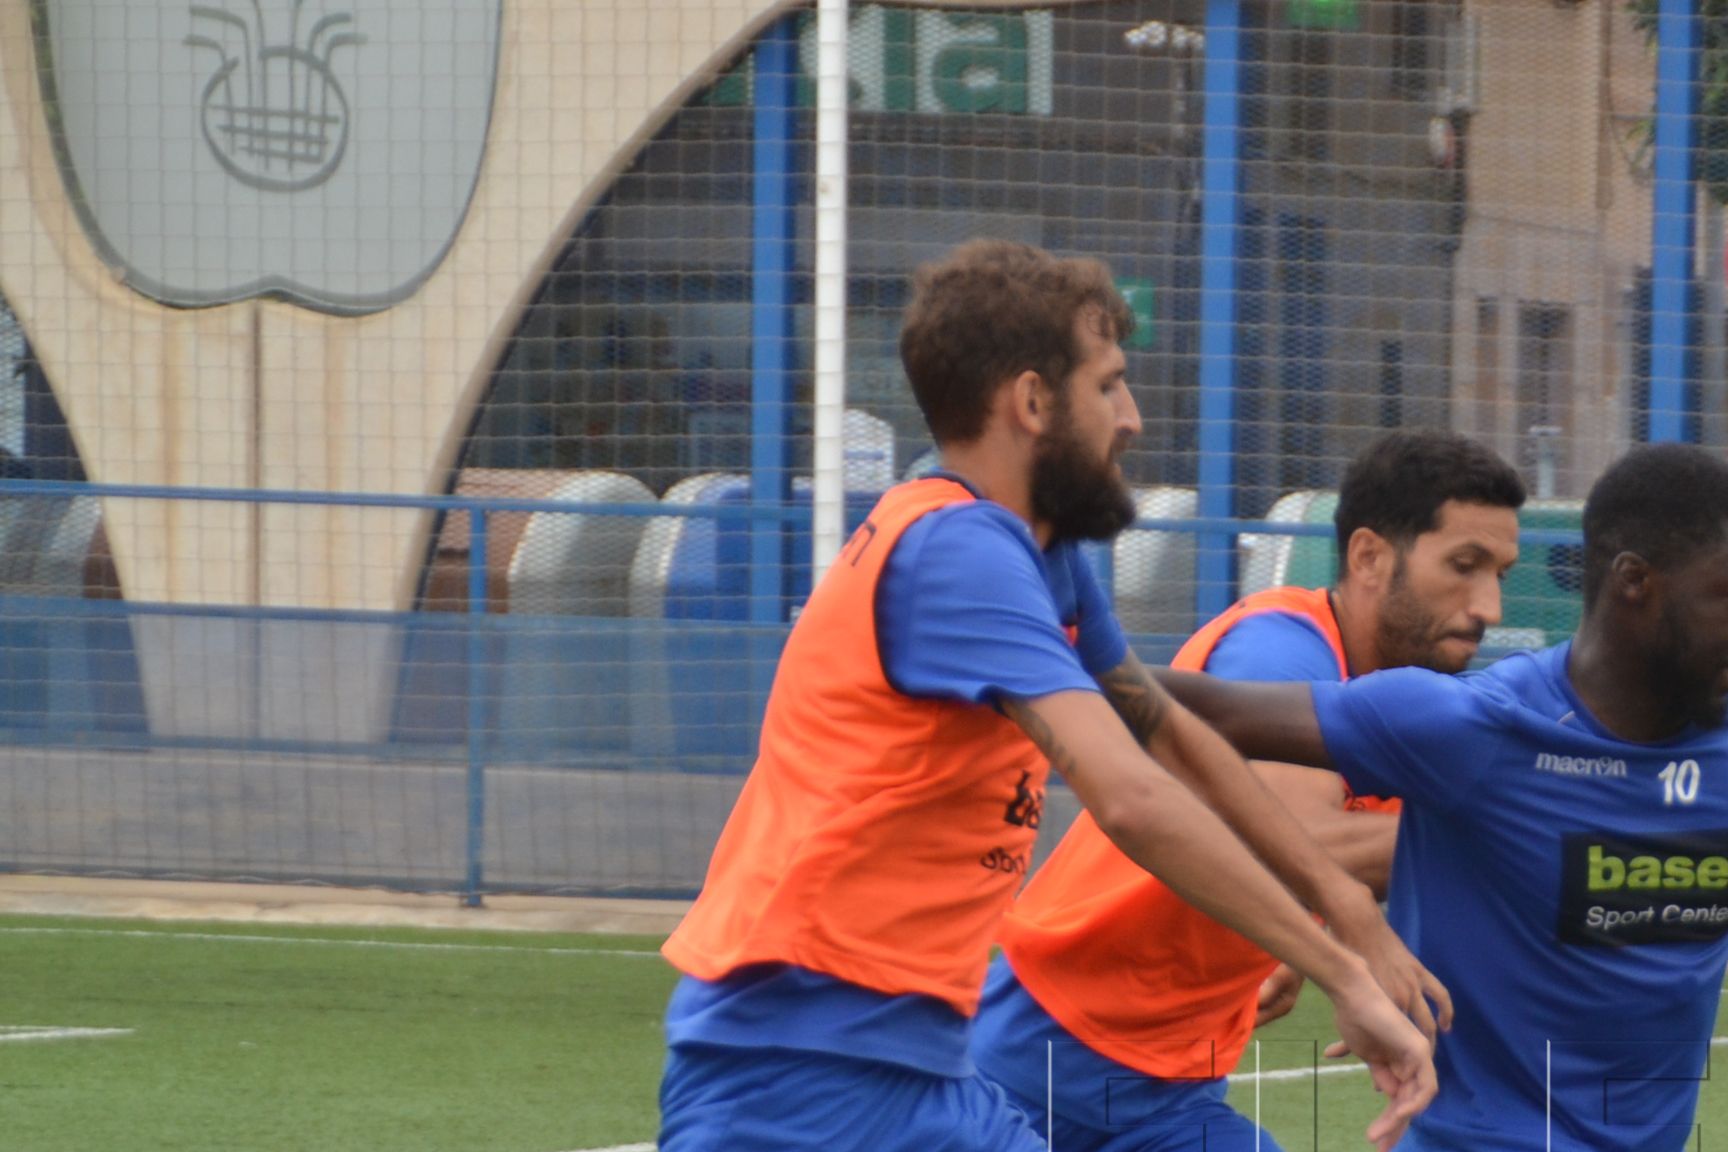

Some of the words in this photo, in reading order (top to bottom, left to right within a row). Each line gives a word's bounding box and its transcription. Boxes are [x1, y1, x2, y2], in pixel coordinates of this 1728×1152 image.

[1535, 752, 1627, 778] macron
[1658, 759, 1700, 805] 10
[1586, 906, 1654, 929] Sport
